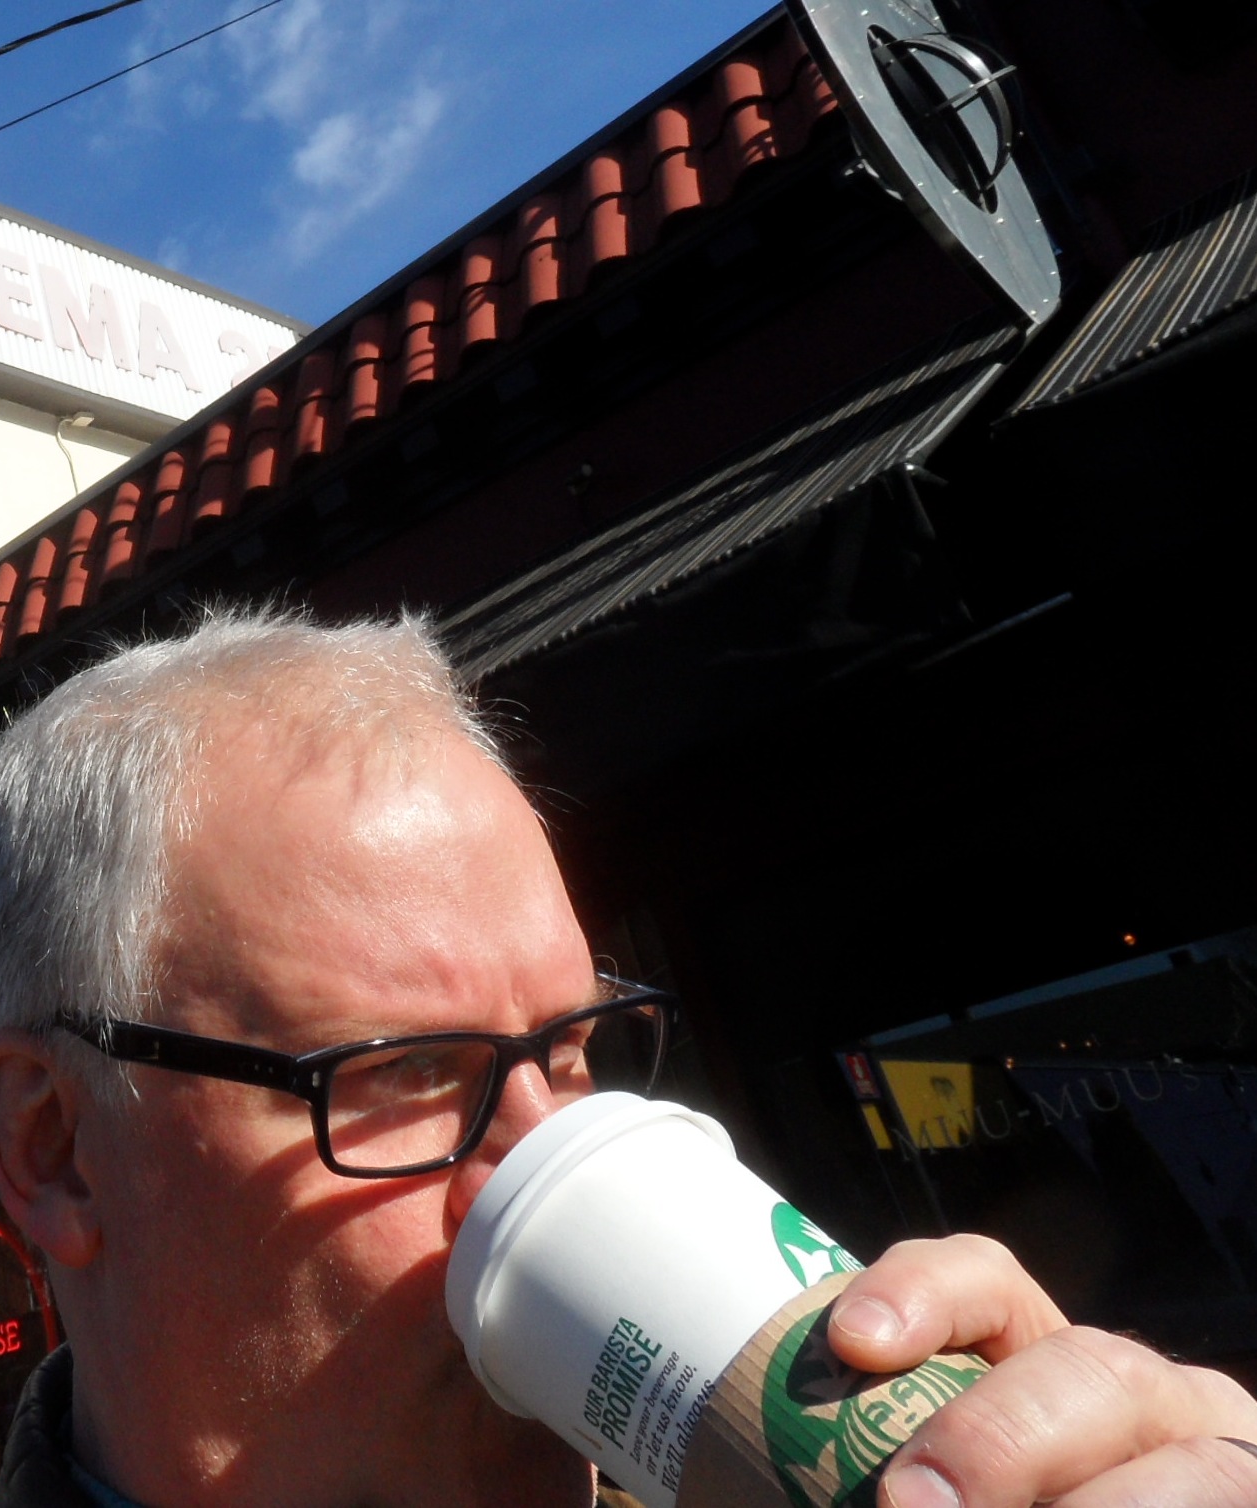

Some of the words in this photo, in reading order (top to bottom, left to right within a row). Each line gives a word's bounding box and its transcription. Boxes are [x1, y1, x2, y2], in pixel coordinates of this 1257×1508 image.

[217, 329, 285, 389] 2
[591, 1316, 638, 1392] BARISTA
[584, 1389, 605, 1428] OUR
[600, 1329, 663, 1450] PROMISE
[637, 1407, 651, 1437] your
[644, 1351, 680, 1407] beverage
[661, 1365, 698, 1415] know.
[645, 1432, 663, 1458] let
[656, 1412, 671, 1435] us
[646, 1456, 657, 1476] or
[661, 1443, 685, 1494] We'll
